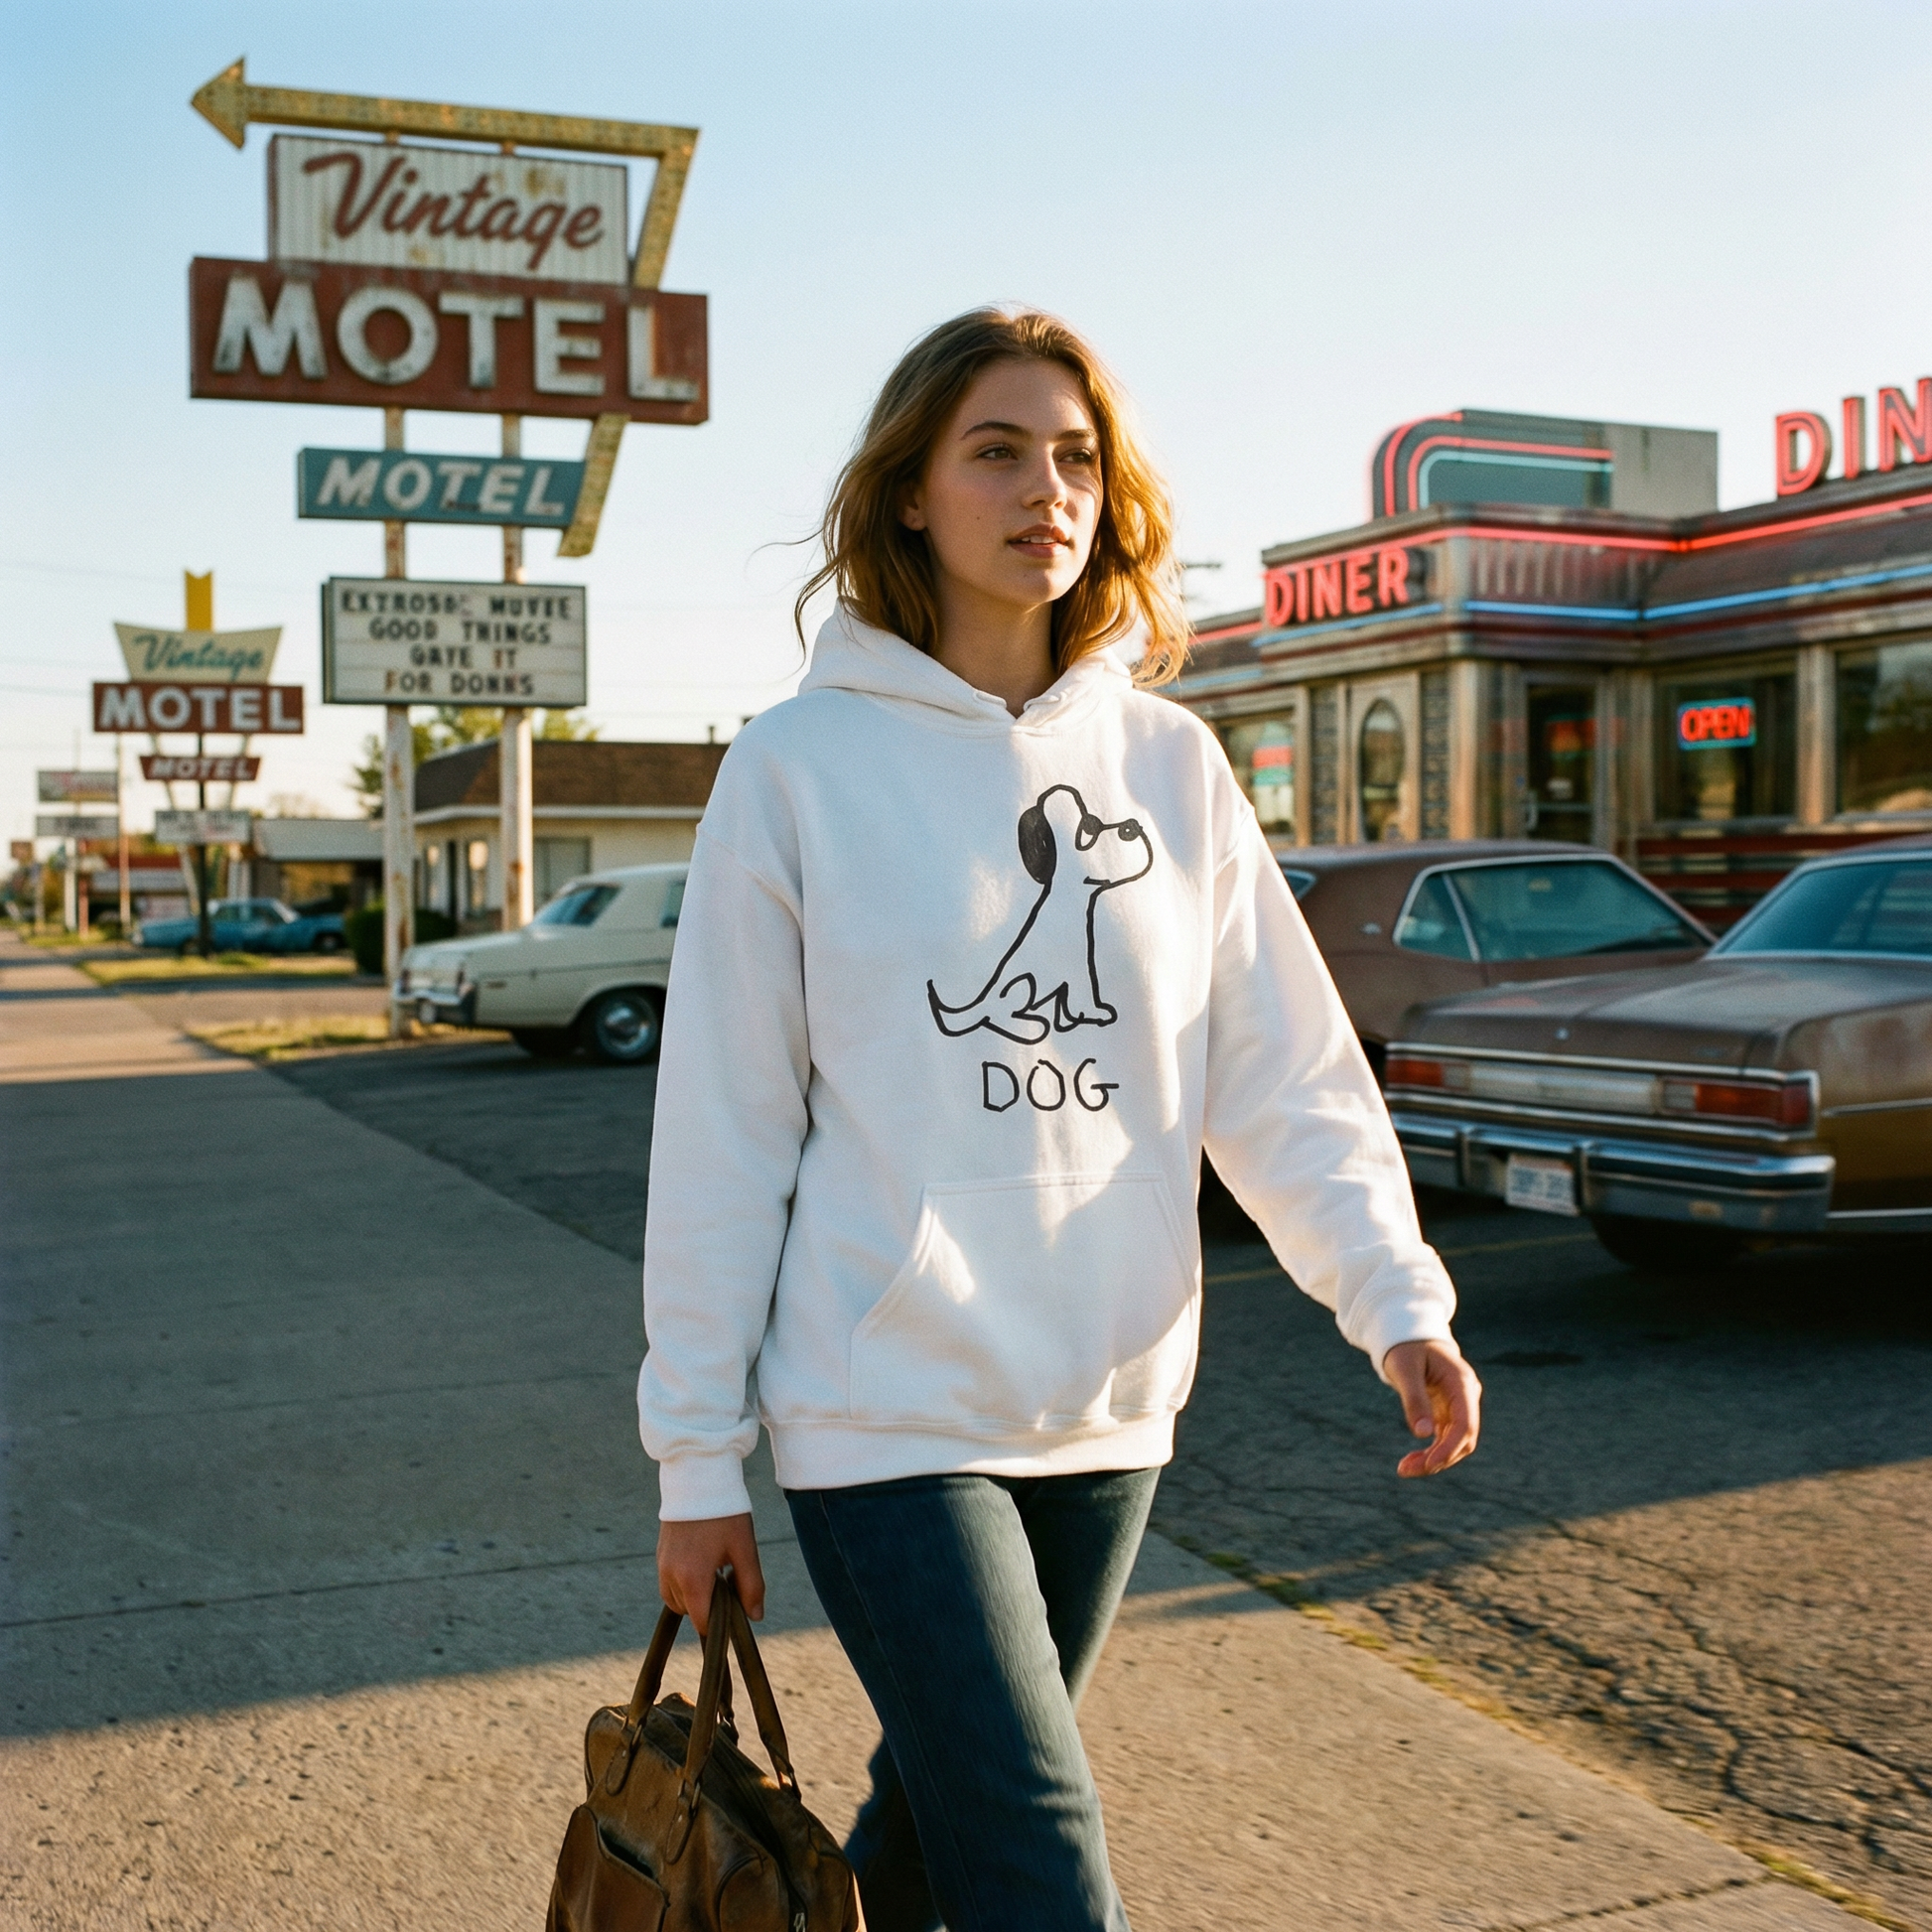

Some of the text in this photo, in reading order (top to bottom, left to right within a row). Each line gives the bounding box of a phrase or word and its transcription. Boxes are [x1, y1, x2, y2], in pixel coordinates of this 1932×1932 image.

[303, 152, 604, 270] Vintage
[212, 275, 699, 400] MOTEL
[1775, 376, 1932, 495] DIN
[317, 459, 563, 515] MOTEL
[1265, 547, 1409, 627] DINER
[368, 617, 550, 644] GOOD THINGS
[132, 633, 263, 682] Vintage
[384, 670, 431, 694] FOR
[100, 686, 301, 730] MOTEL
[1681, 706, 1749, 742] OPEN
[150, 758, 252, 778] MOTEL
[982, 1057, 1120, 1112] DOG
